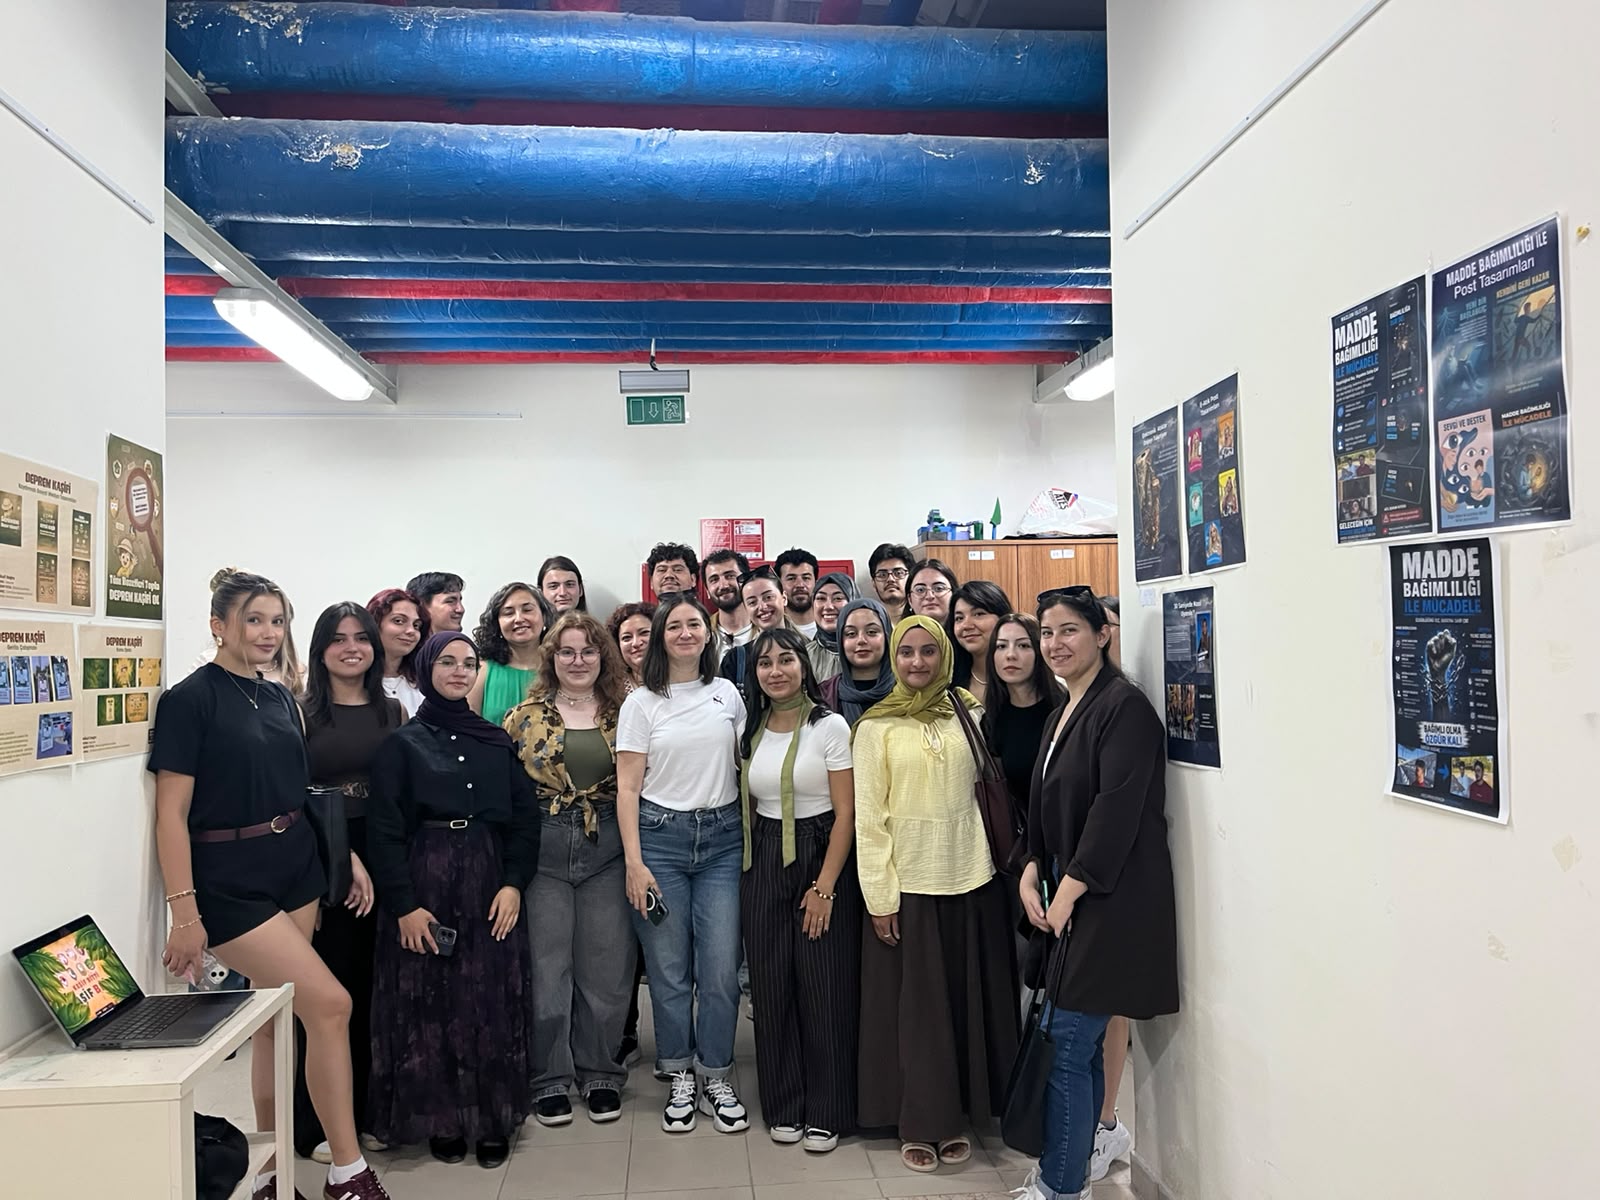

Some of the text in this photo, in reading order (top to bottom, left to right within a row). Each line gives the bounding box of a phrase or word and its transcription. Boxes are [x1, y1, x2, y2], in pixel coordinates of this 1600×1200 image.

[1446, 231, 1548, 288] MADDE BAĞIMLILIĞI İLE
[1454, 280, 1477, 299] Post
[1479, 257, 1535, 289] Tasarımları
[1335, 311, 1378, 351] MADDE
[1335, 335, 1379, 366] BAĞIMLILIĞI
[1346, 353, 1379, 374] MÜCADELE
[1443, 414, 1486, 431] SEVGİ VE DESTEK
[1501, 411, 1520, 419] MADDE
[1514, 409, 1552, 425] MÜCADELE
[25, 472, 71, 495] DEPREM KAŞİFİ
[1402, 547, 1480, 580] MADDE
[1403, 577, 1481, 598] BAĞIMLILIĞI
[109, 589, 133, 603] DEPREM
[134, 591, 151, 605] KAŞİFİ
[1422, 597, 1481, 613] MÜCADELE
[25, 630, 45, 646] KAŞİFİ
[106, 636, 142, 648] DEPREM KAŞİFİ
[1424, 723, 1462, 735] BAĞIMLI OLMA
[1425, 733, 1462, 745] ÖZGÜR KAL!
